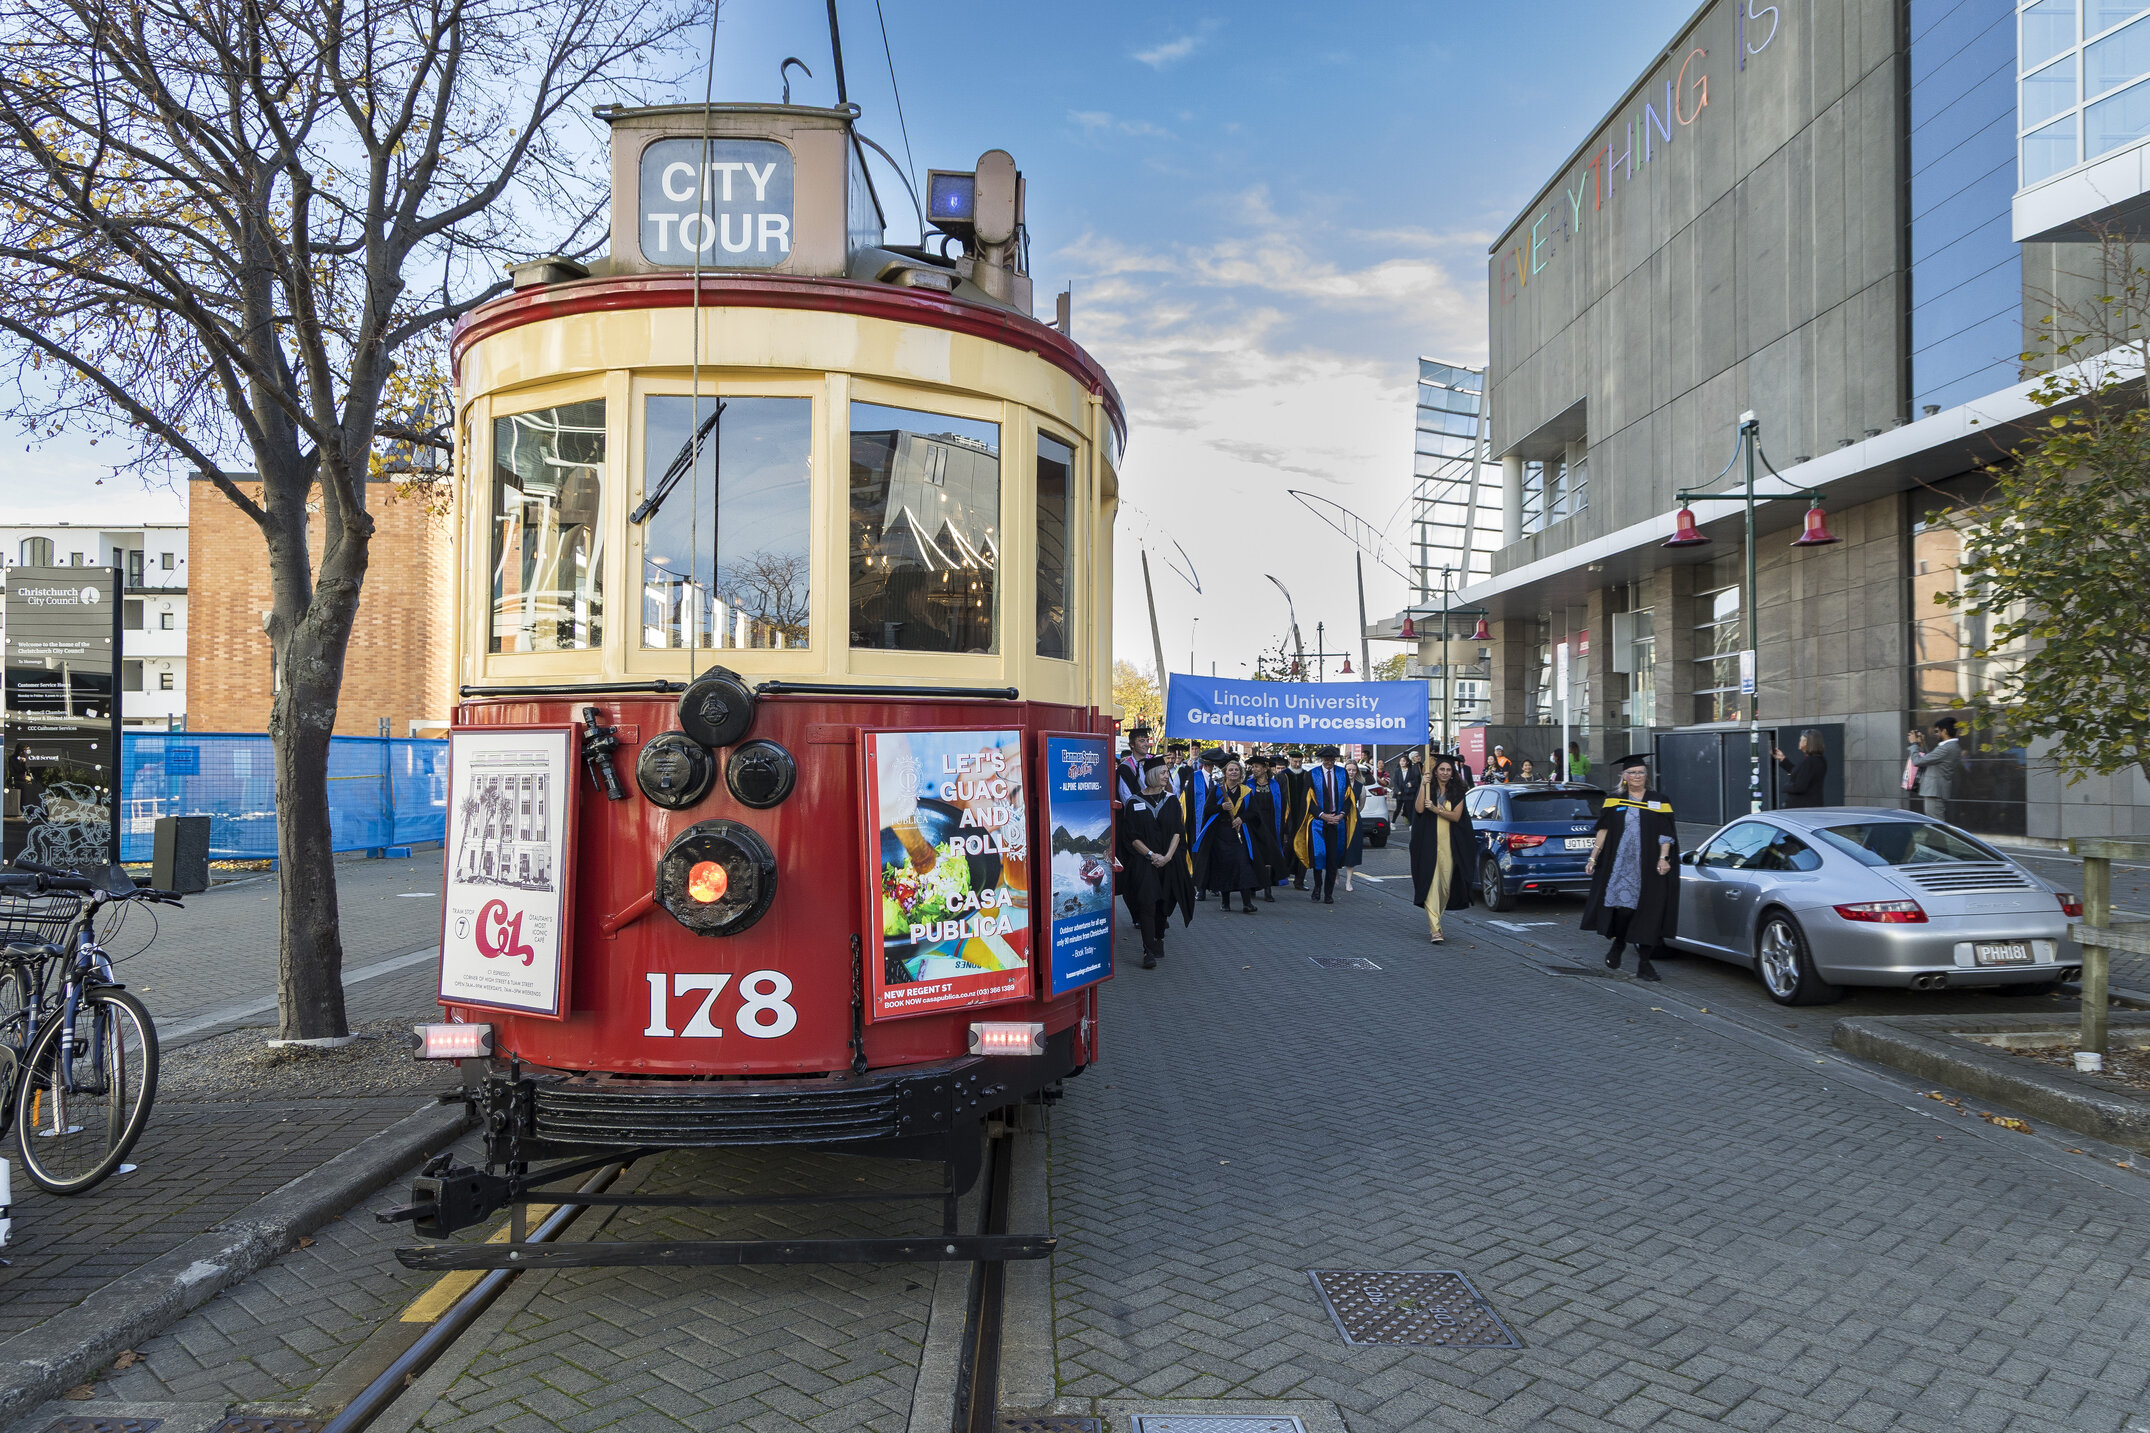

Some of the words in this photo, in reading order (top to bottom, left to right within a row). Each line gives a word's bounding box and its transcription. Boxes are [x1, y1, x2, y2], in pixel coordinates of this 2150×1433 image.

[1500, 47, 1709, 307] EVERYTHING
[1738, 0, 1779, 72] IS
[661, 161, 777, 202] CITY
[647, 211, 791, 253] TOUR
[18, 587, 78, 596] Christchurch
[27, 597, 45, 606] City
[46, 597, 78, 605] Council
[1213, 690, 1279, 708] Lincoln
[1285, 693, 1379, 711] University
[1187, 708, 1293, 728] Graduation
[1299, 714, 1406, 729] Procession
[942, 752, 1006, 774] LET'S
[940, 780, 1009, 802] GUAC
[1062, 782, 1077, 791] ALPINE
[1077, 782, 1100, 790] ADVENTURES
[891, 816, 929, 825] PUBLICA
[959, 806, 1010, 828] AND
[949, 833, 1011, 857] ROLL
[945, 887, 1013, 912] CASA
[459, 920, 466, 936] 7
[910, 915, 1014, 944] PUBLICA
[1060, 926, 1074, 935] Outdoor
[1074, 922, 1091, 931] adventures
[1099, 917, 1107, 926] ages
[1056, 938, 1065, 947] only
[1065, 937, 1069, 945] 90
[1069, 934, 1082, 943] minutes
[1075, 948, 1083, 957] Book
[1084, 946, 1094, 955] Today
[1982, 945, 2028, 960] PHH181
[495, 977, 507, 985] STREET
[884, 989, 905, 1000] NEW
[906, 985, 940, 997] REGENT
[942, 983, 953, 992] ST
[884, 1000, 905, 1008] BOOK
[905, 998, 922, 1006] NOW
[922, 991, 976, 1003] casapublica.co.nz
[977, 988, 989, 996] (03)
[643, 969, 798, 1039] 178
